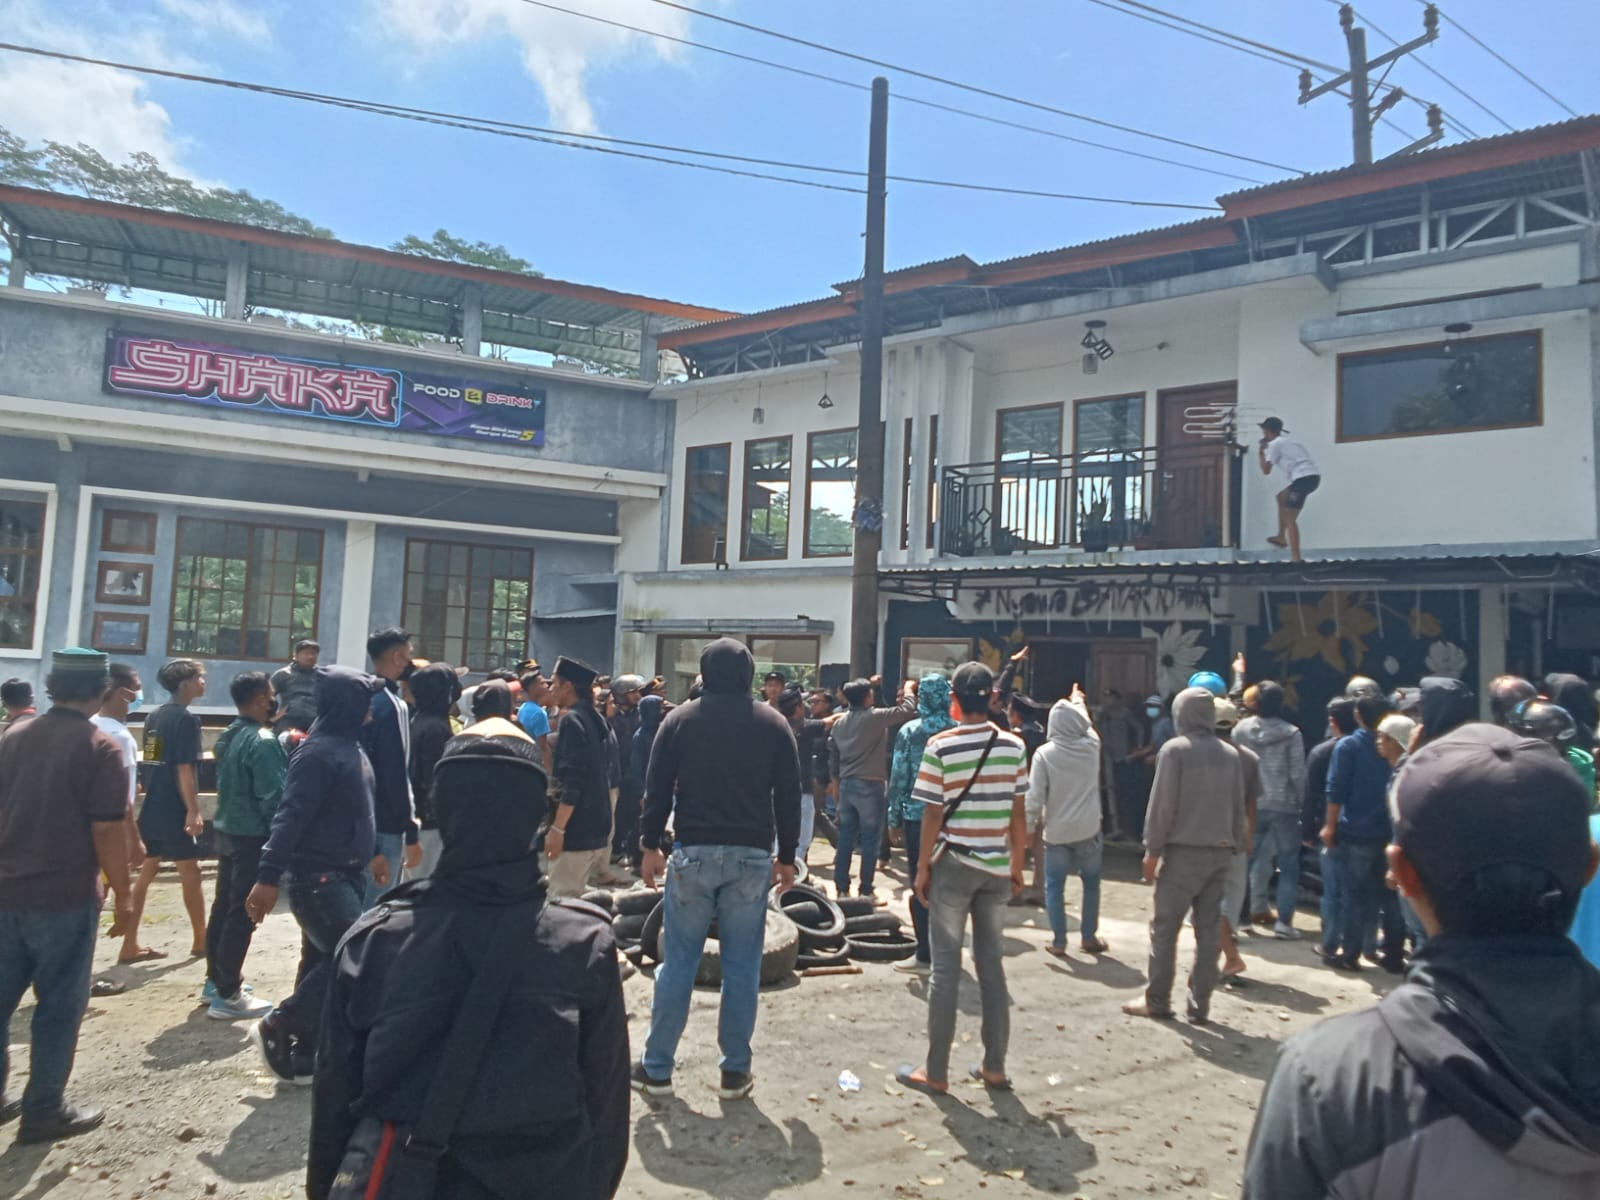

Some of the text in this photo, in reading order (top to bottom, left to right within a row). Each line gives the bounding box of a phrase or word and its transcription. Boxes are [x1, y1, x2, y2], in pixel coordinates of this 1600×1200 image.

[112, 342, 390, 416] SHAKA
[413, 383, 460, 399] FOOD
[486, 392, 532, 409] DRINK
